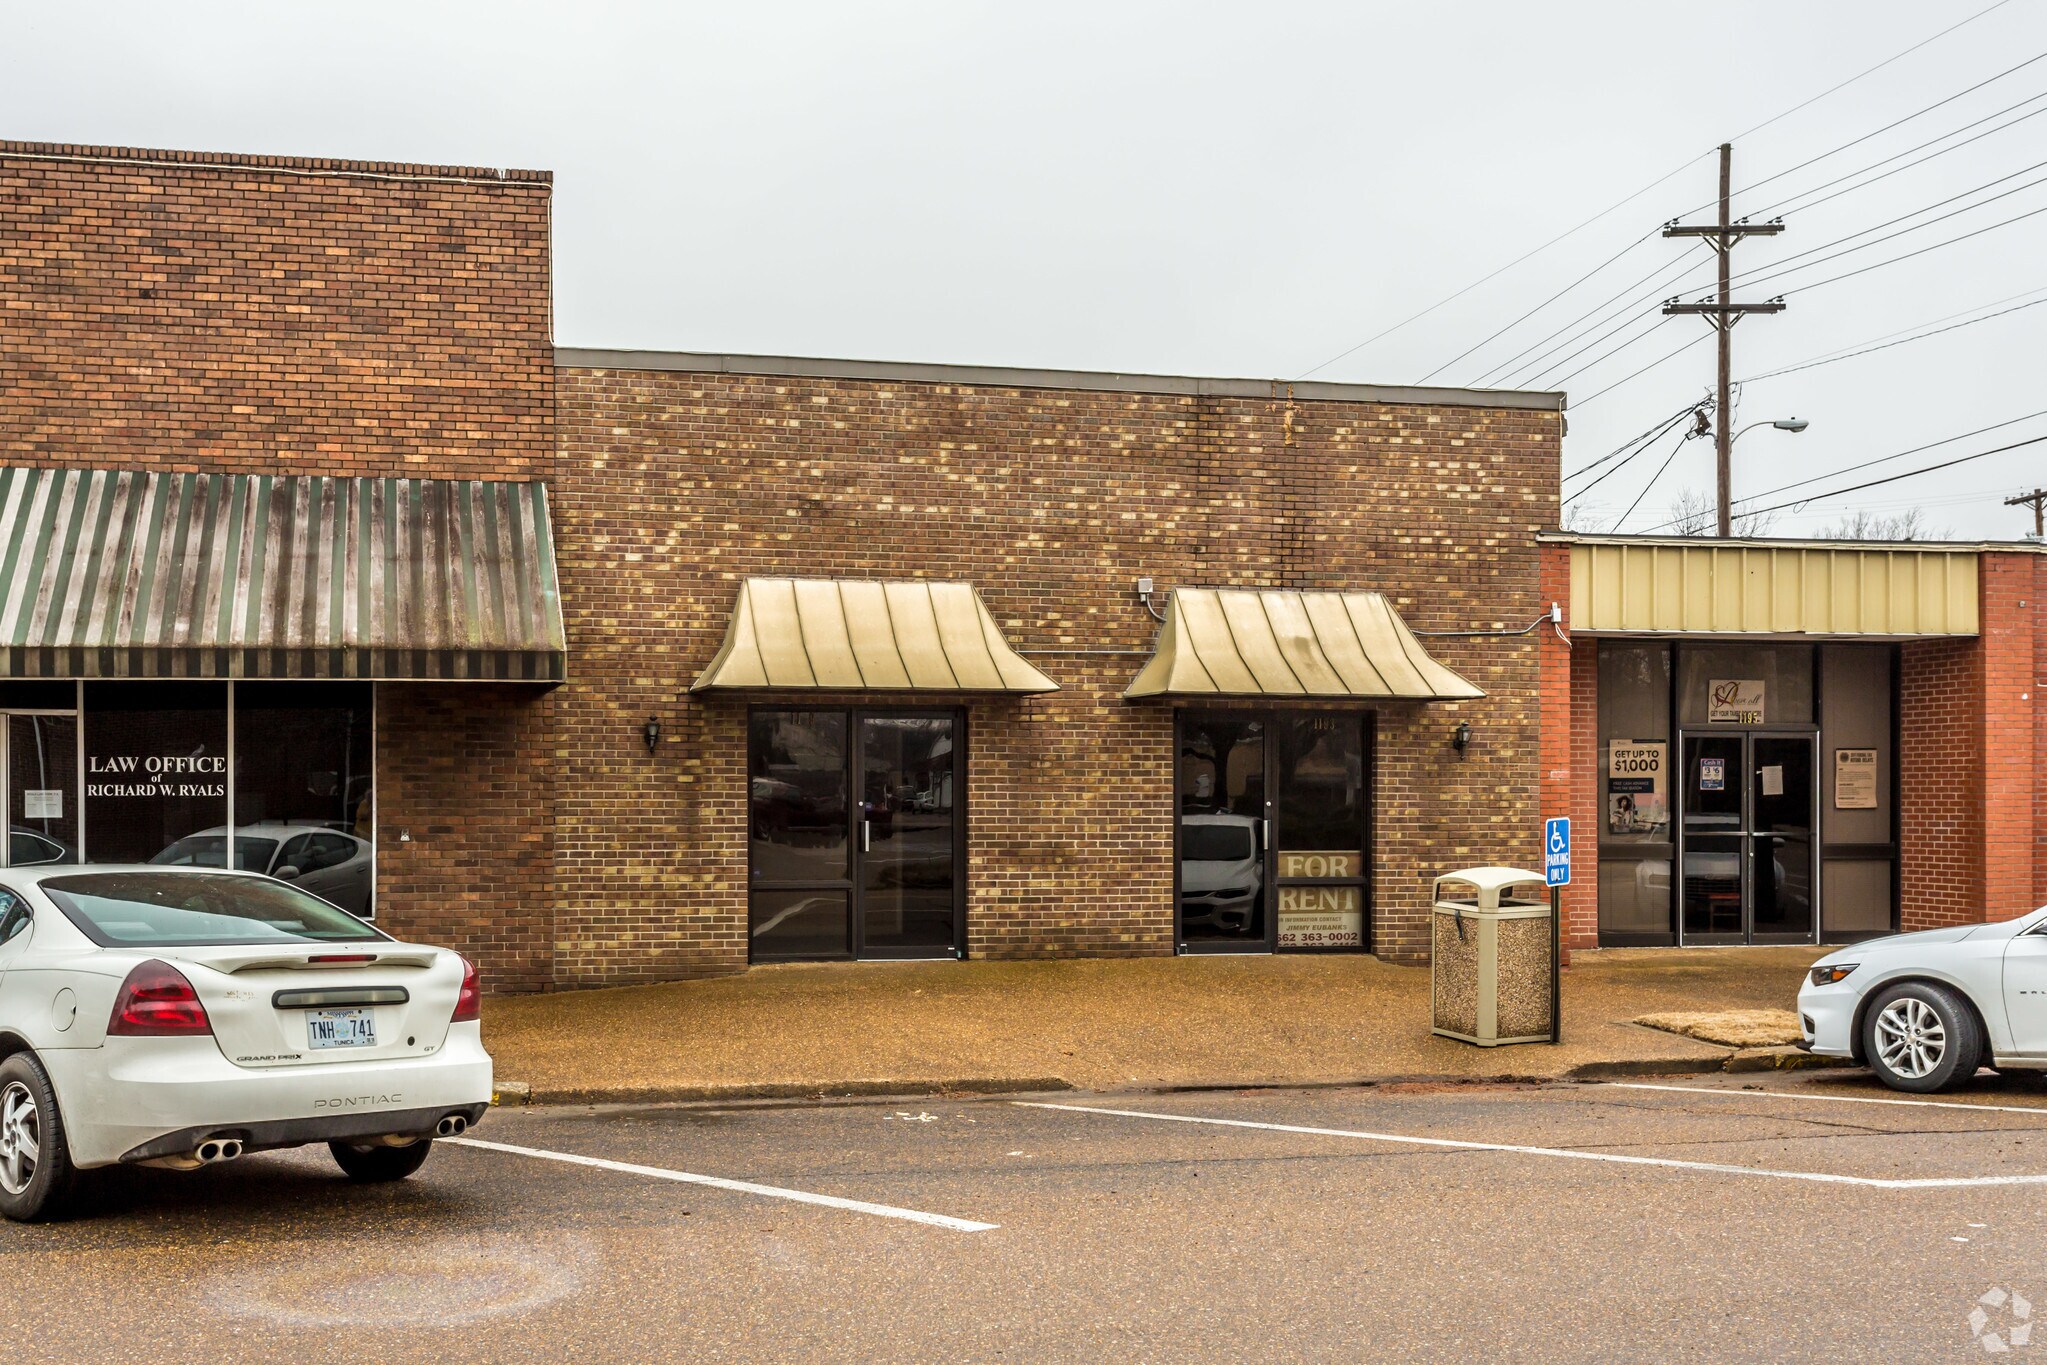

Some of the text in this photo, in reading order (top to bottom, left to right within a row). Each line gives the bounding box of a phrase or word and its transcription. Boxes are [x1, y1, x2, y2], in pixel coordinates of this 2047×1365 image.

[1739, 712, 1758, 724] 1195
[1615, 750, 1659, 758] GET UP TO
[89, 756, 226, 773] LAW OFFICE
[1615, 759, 1659, 773] $1,000
[151, 774, 162, 783] of
[87, 784, 225, 796] RICHARD W. RYALS
[1547, 852, 1569, 866] PARKING
[1287, 856, 1349, 877] FOR
[1551, 868, 1565, 881] ONLY
[1278, 887, 1357, 910] RENT
[1301, 932, 1358, 941] 363-0002
[310, 1019, 374, 1039] TNH 741
[314, 1093, 402, 1109] PONTIAC
